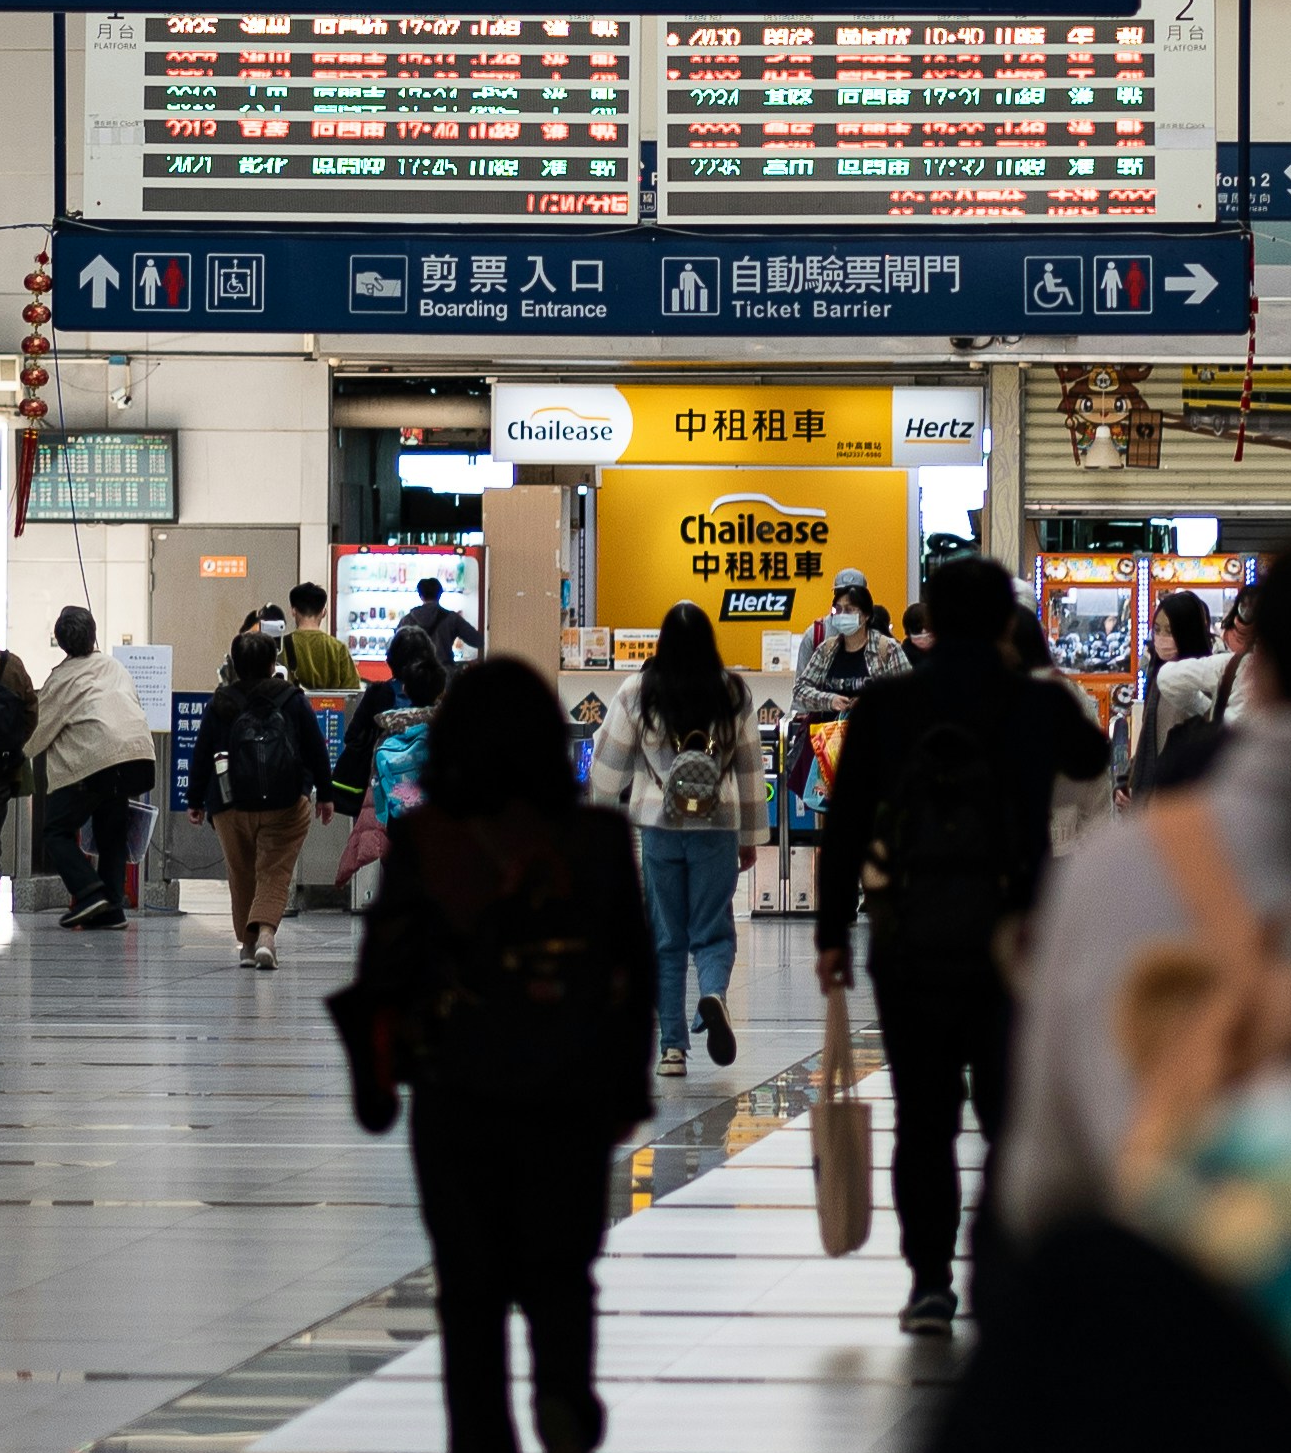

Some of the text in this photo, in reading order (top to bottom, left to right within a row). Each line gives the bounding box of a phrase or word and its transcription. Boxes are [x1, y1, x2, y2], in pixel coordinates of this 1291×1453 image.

[96, 23, 135, 40] 月台
[1166, 24, 1205, 42] 月台
[93, 42, 137, 50] PLATFORM
[1163, 43, 1207, 53] PLATFORM
[1260, 172, 1271, 187] 2
[420, 253, 605, 294] 剪票入口
[731, 254, 960, 295] 自動驗票閘門
[419, 299, 607, 322] Boarding Entrance
[731, 300, 892, 318] Ticket Barrier
[507, 420, 613, 441] Chailease
[675, 407, 827, 443] 中租租車
[905, 418, 976, 439] Hertz
[680, 513, 830, 544] Chailease
[692, 550, 824, 583] 中租租車
[728, 592, 788, 612] Hertz
[762, 892, 807, 902] 2 3
